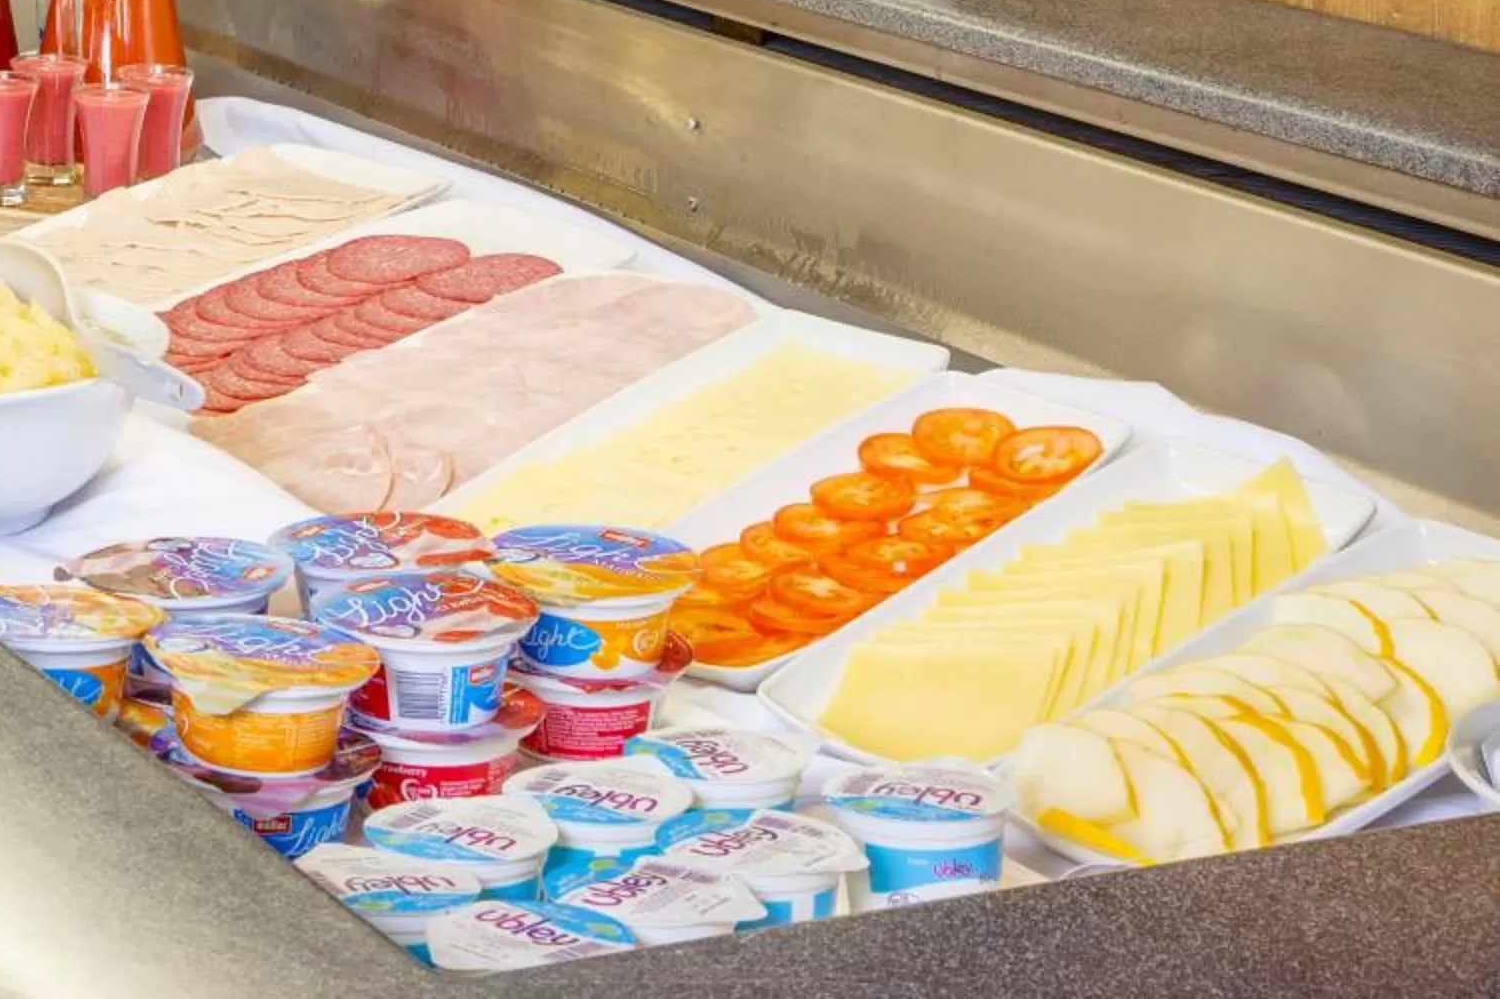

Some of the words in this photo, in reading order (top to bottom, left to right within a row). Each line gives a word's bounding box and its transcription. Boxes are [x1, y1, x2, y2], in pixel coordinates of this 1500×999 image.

[524, 622, 603, 660] ight
[553, 783, 659, 814] ubley
[870, 780, 983, 807] ubley
[344, 873, 457, 896] ubley
